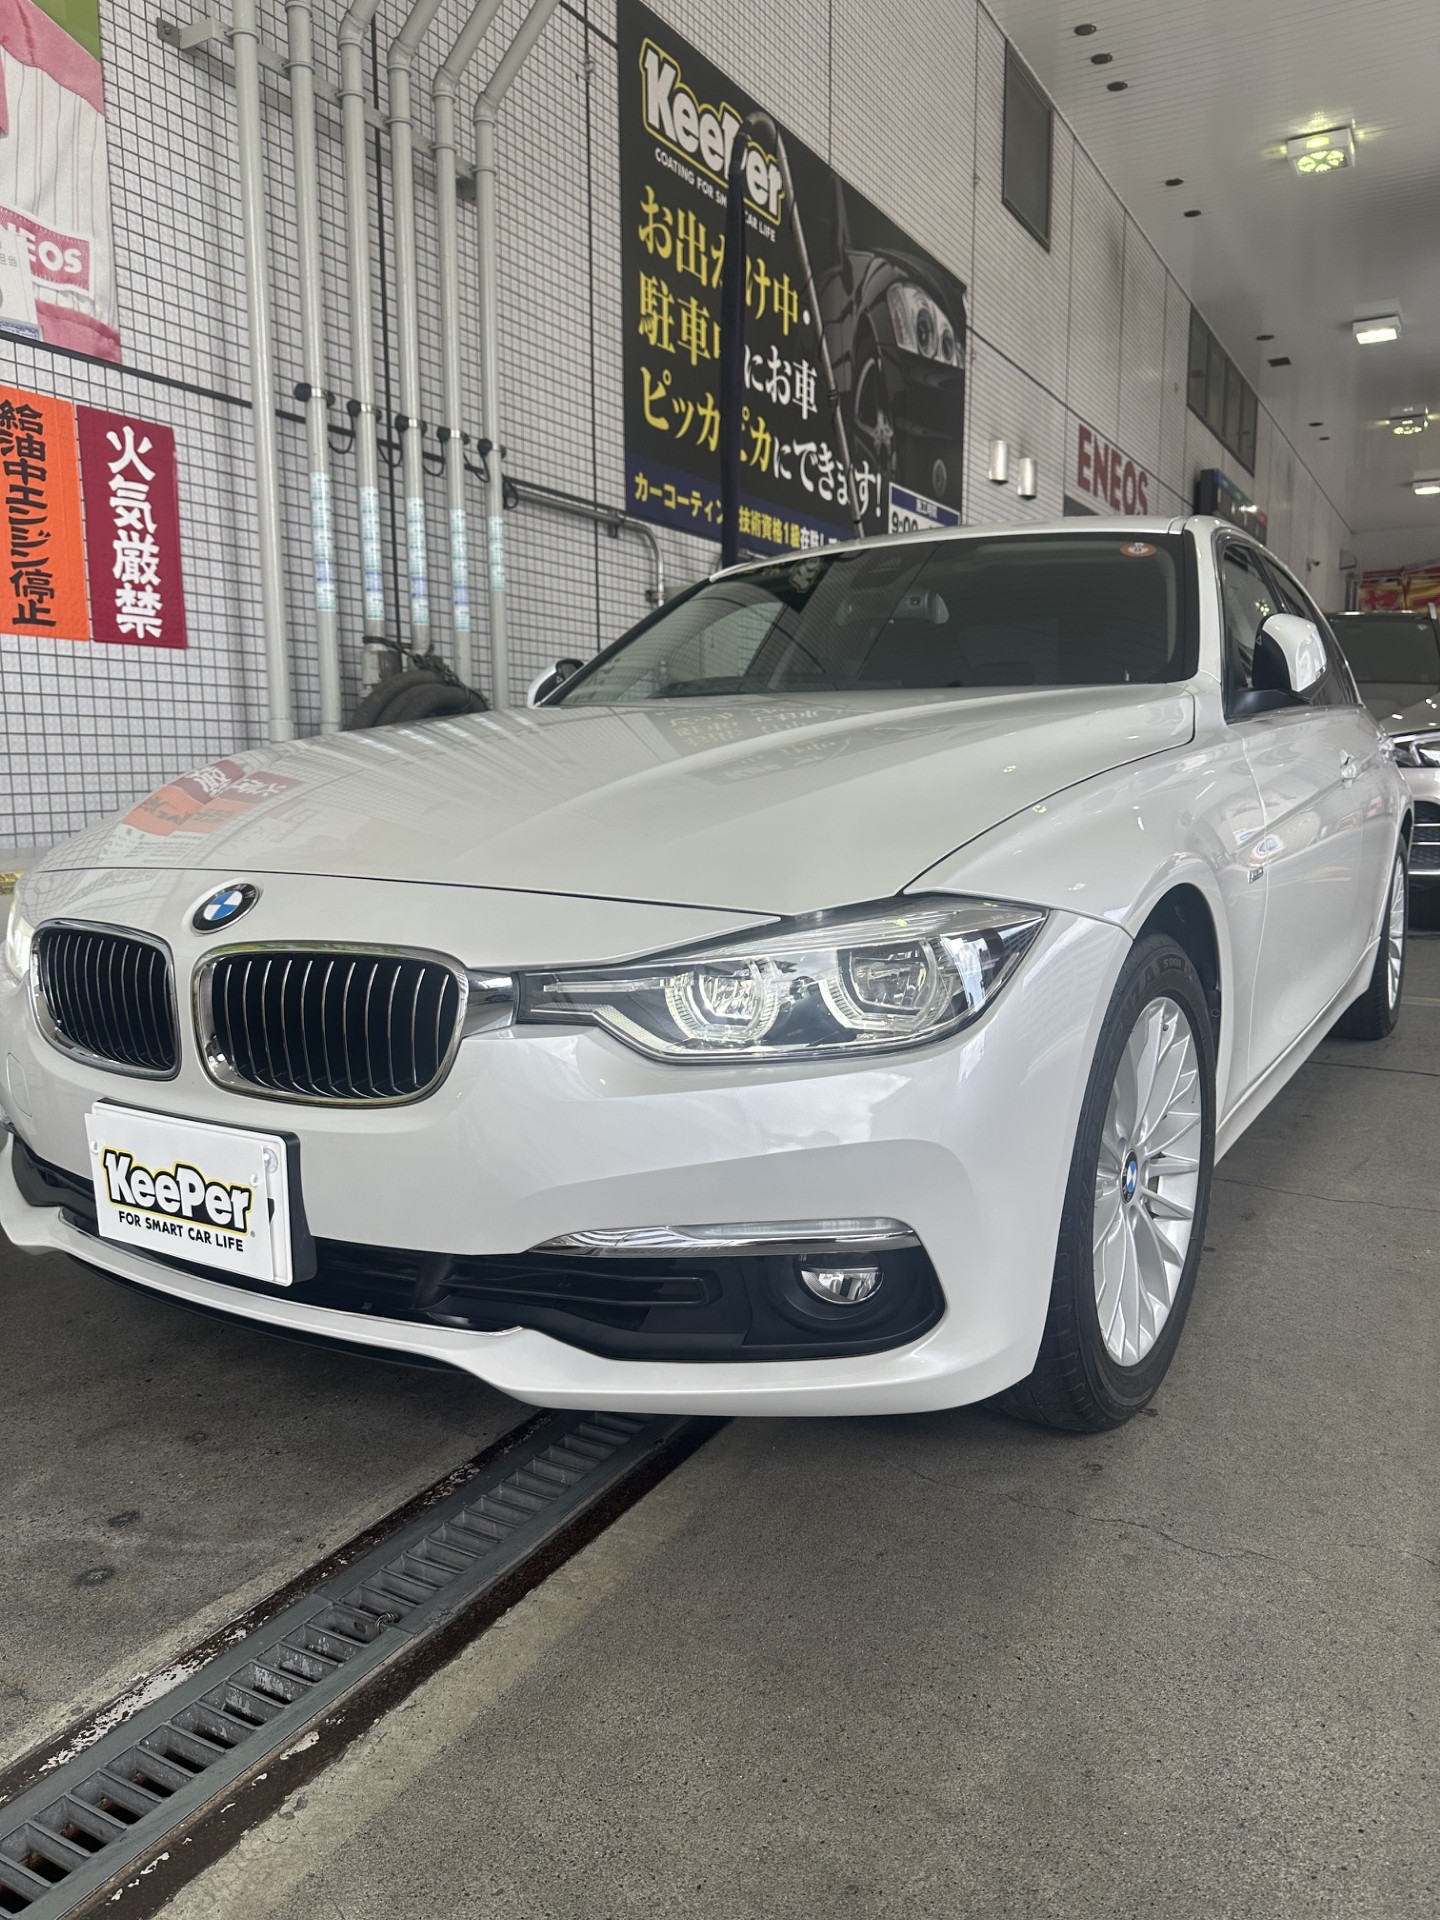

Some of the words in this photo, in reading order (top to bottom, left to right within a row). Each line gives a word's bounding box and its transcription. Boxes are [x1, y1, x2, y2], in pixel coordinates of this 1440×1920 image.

[655, 148, 695, 186] COATING
[696, 177, 717, 200] FOR
[758, 219, 776, 242] LIFE
[638, 271, 818, 420] 駐車にお車
[0, 398, 56, 627] 給油中エンジン停止
[1077, 423, 1148, 515] ENEOS
[106, 425, 163, 639] 火気厳禁
[104, 1149, 251, 1233] KeePer
[119, 1210, 141, 1228] FOR
[145, 1219, 183, 1238] SMART
[187, 1227, 212, 1245] CAR
[215, 1234, 244, 1252] LIFE
